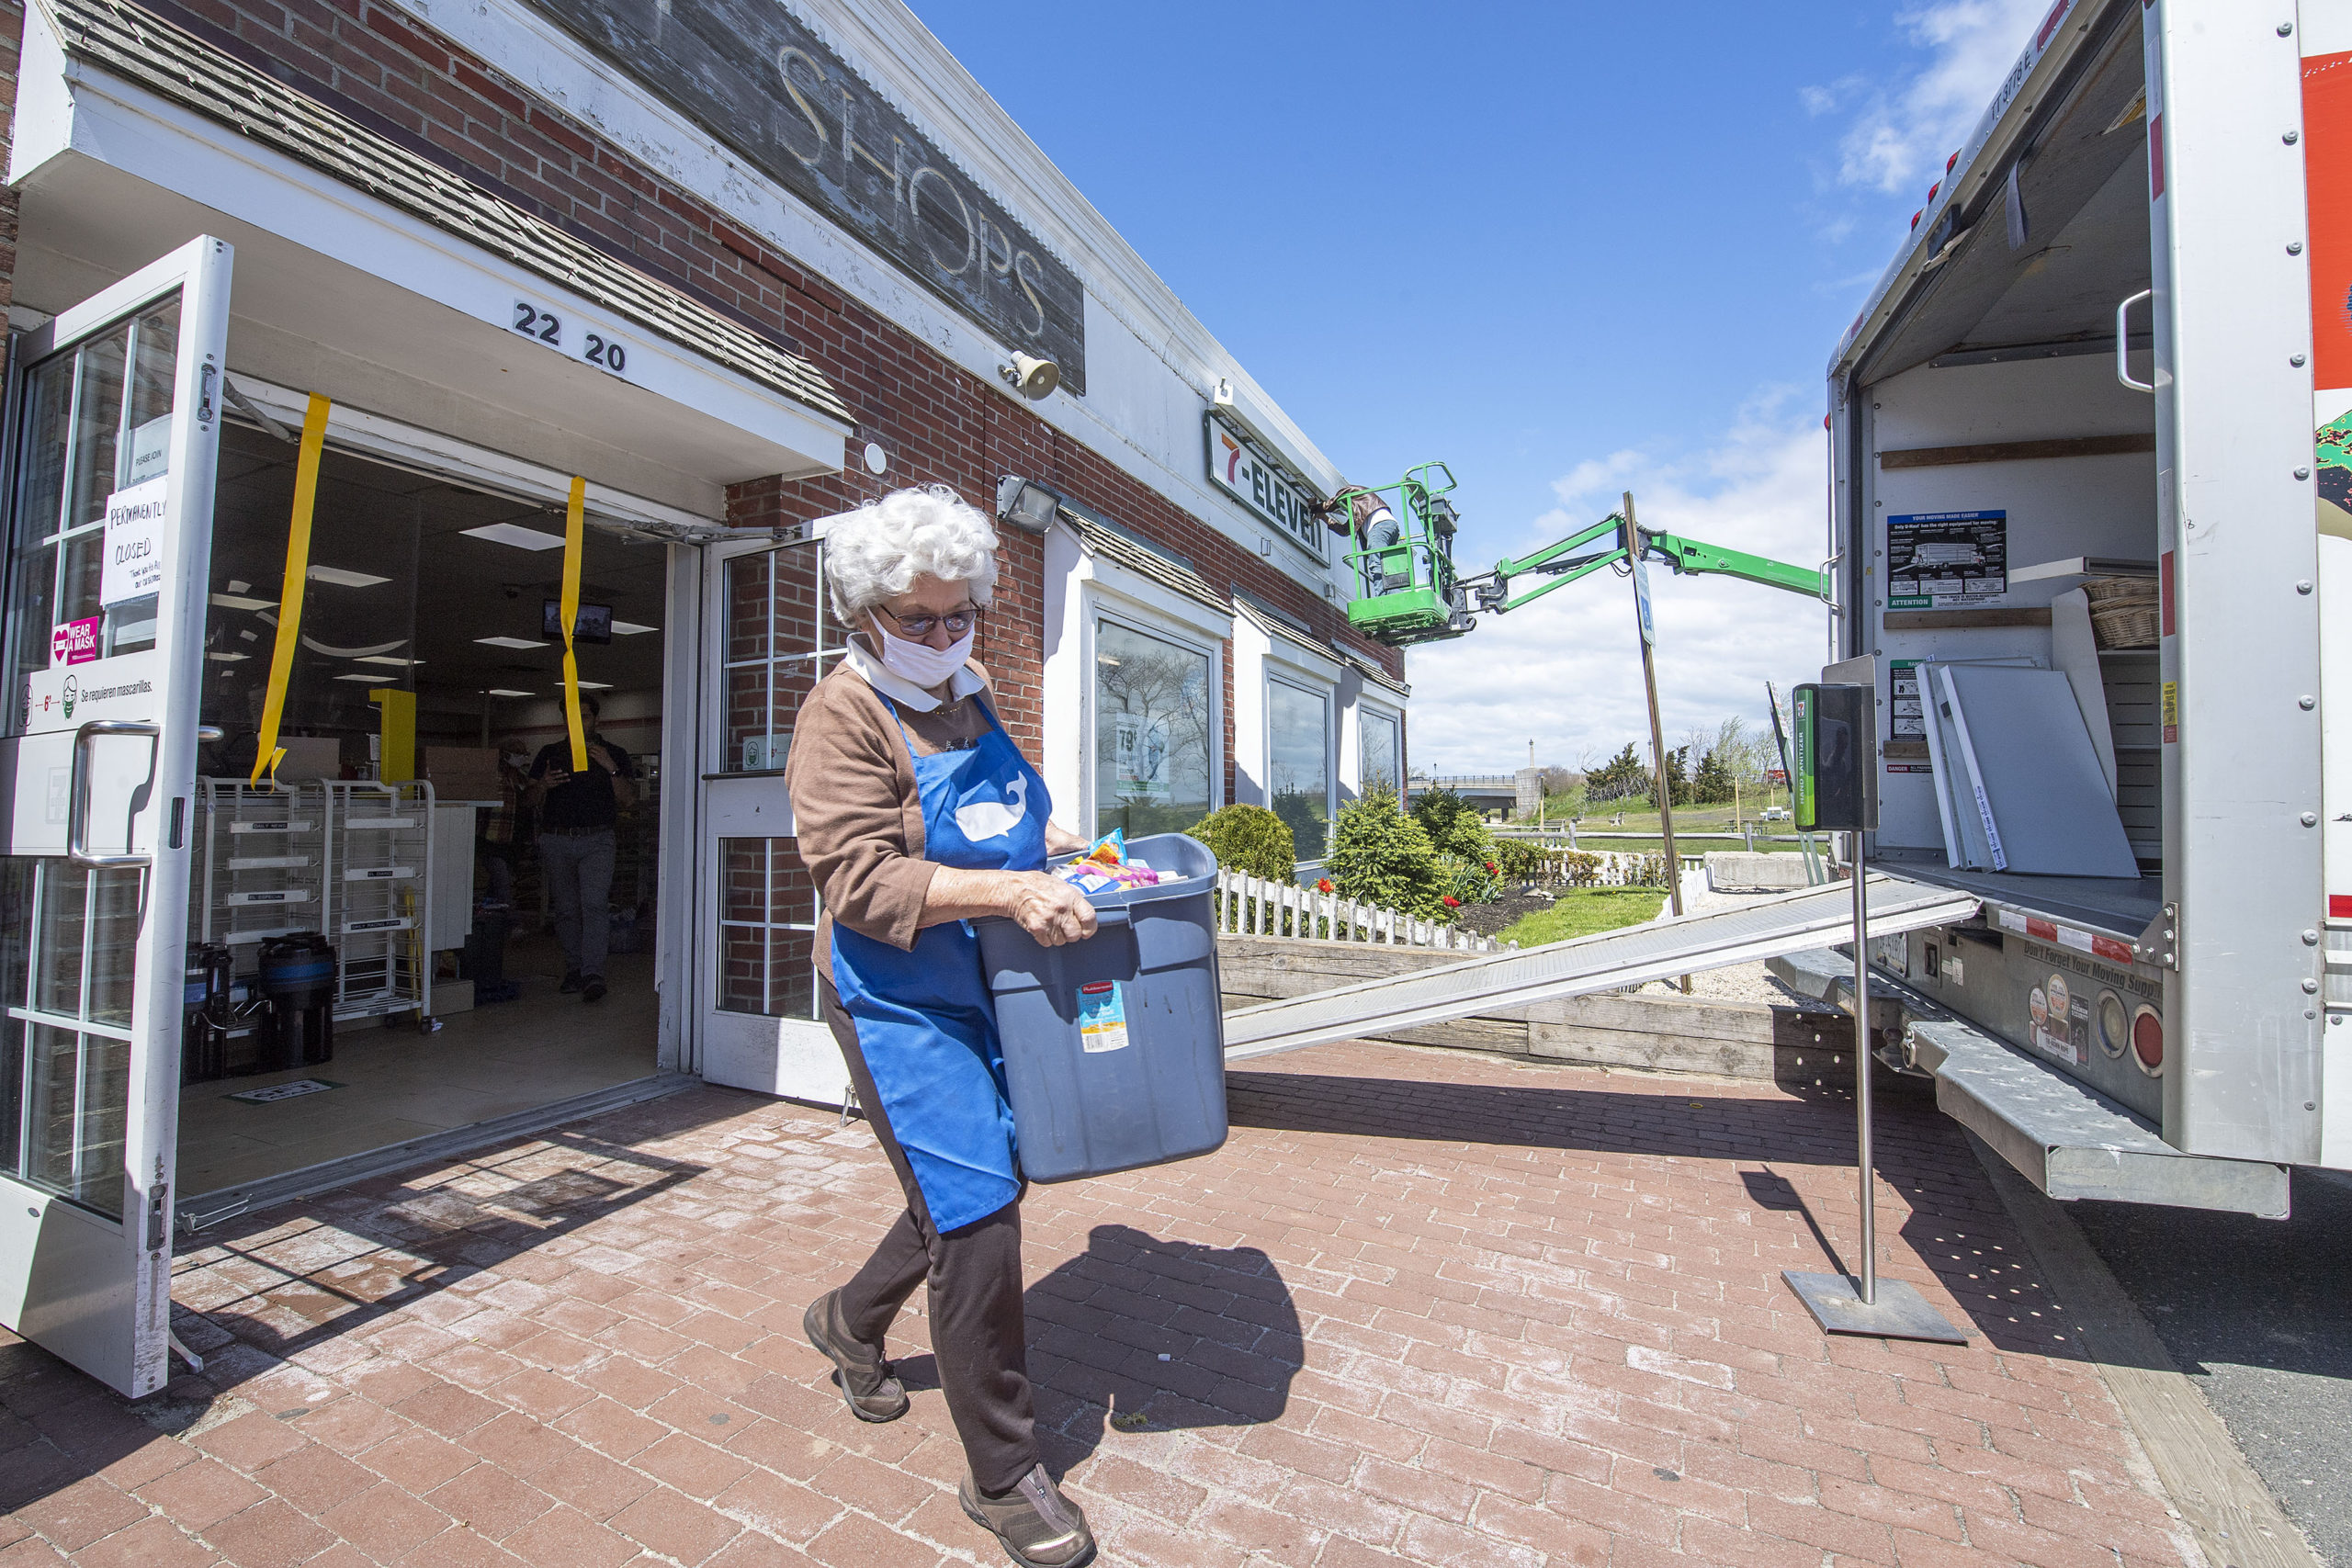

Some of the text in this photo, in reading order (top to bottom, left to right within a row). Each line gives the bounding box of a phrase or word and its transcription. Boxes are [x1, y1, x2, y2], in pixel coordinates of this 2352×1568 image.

[776, 45, 1046, 337] SHOPS
[515, 303, 560, 346] 22
[585, 333, 626, 371] 20
[110, 500, 166, 529] PERMANENTLY
[116, 537, 151, 565] CLOSED
[1892, 598, 1928, 606] ATTENTION
[68, 635, 96, 651] A MASK
[70, 624, 90, 639] WEAR
[81, 689, 89, 702] Se
[89, 687, 117, 704] requieren
[117, 680, 153, 696] mascarillas.
[2024, 941, 2043, 956] Don't
[2045, 947, 2070, 968] Forget
[2071, 956, 2090, 975] Your
[2092, 963, 2125, 989] Moving
